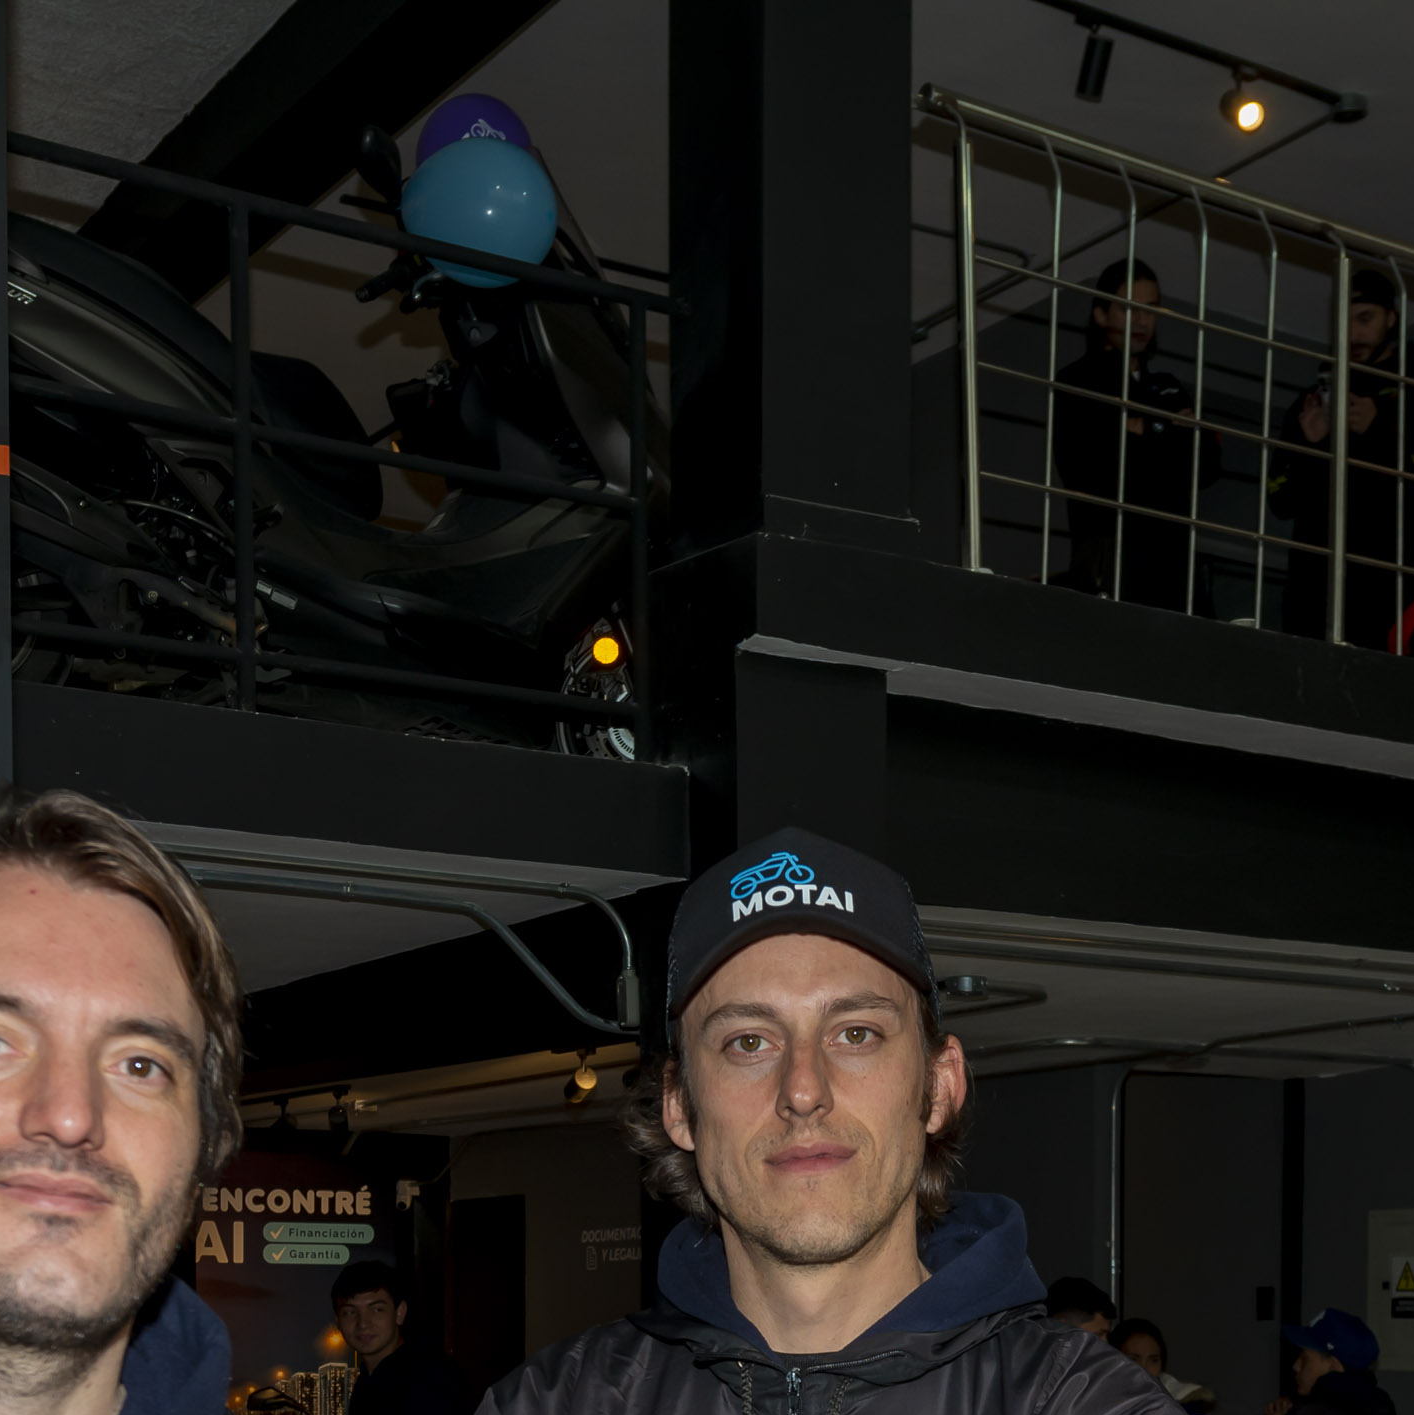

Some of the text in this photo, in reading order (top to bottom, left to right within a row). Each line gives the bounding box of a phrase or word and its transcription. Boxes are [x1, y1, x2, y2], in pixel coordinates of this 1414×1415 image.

[732, 884, 854, 922] MOTAI
[202, 1184, 372, 1216] ENCONTRÉ
[288, 1227, 365, 1239] Financiación
[289, 1248, 341, 1260] Garantía
